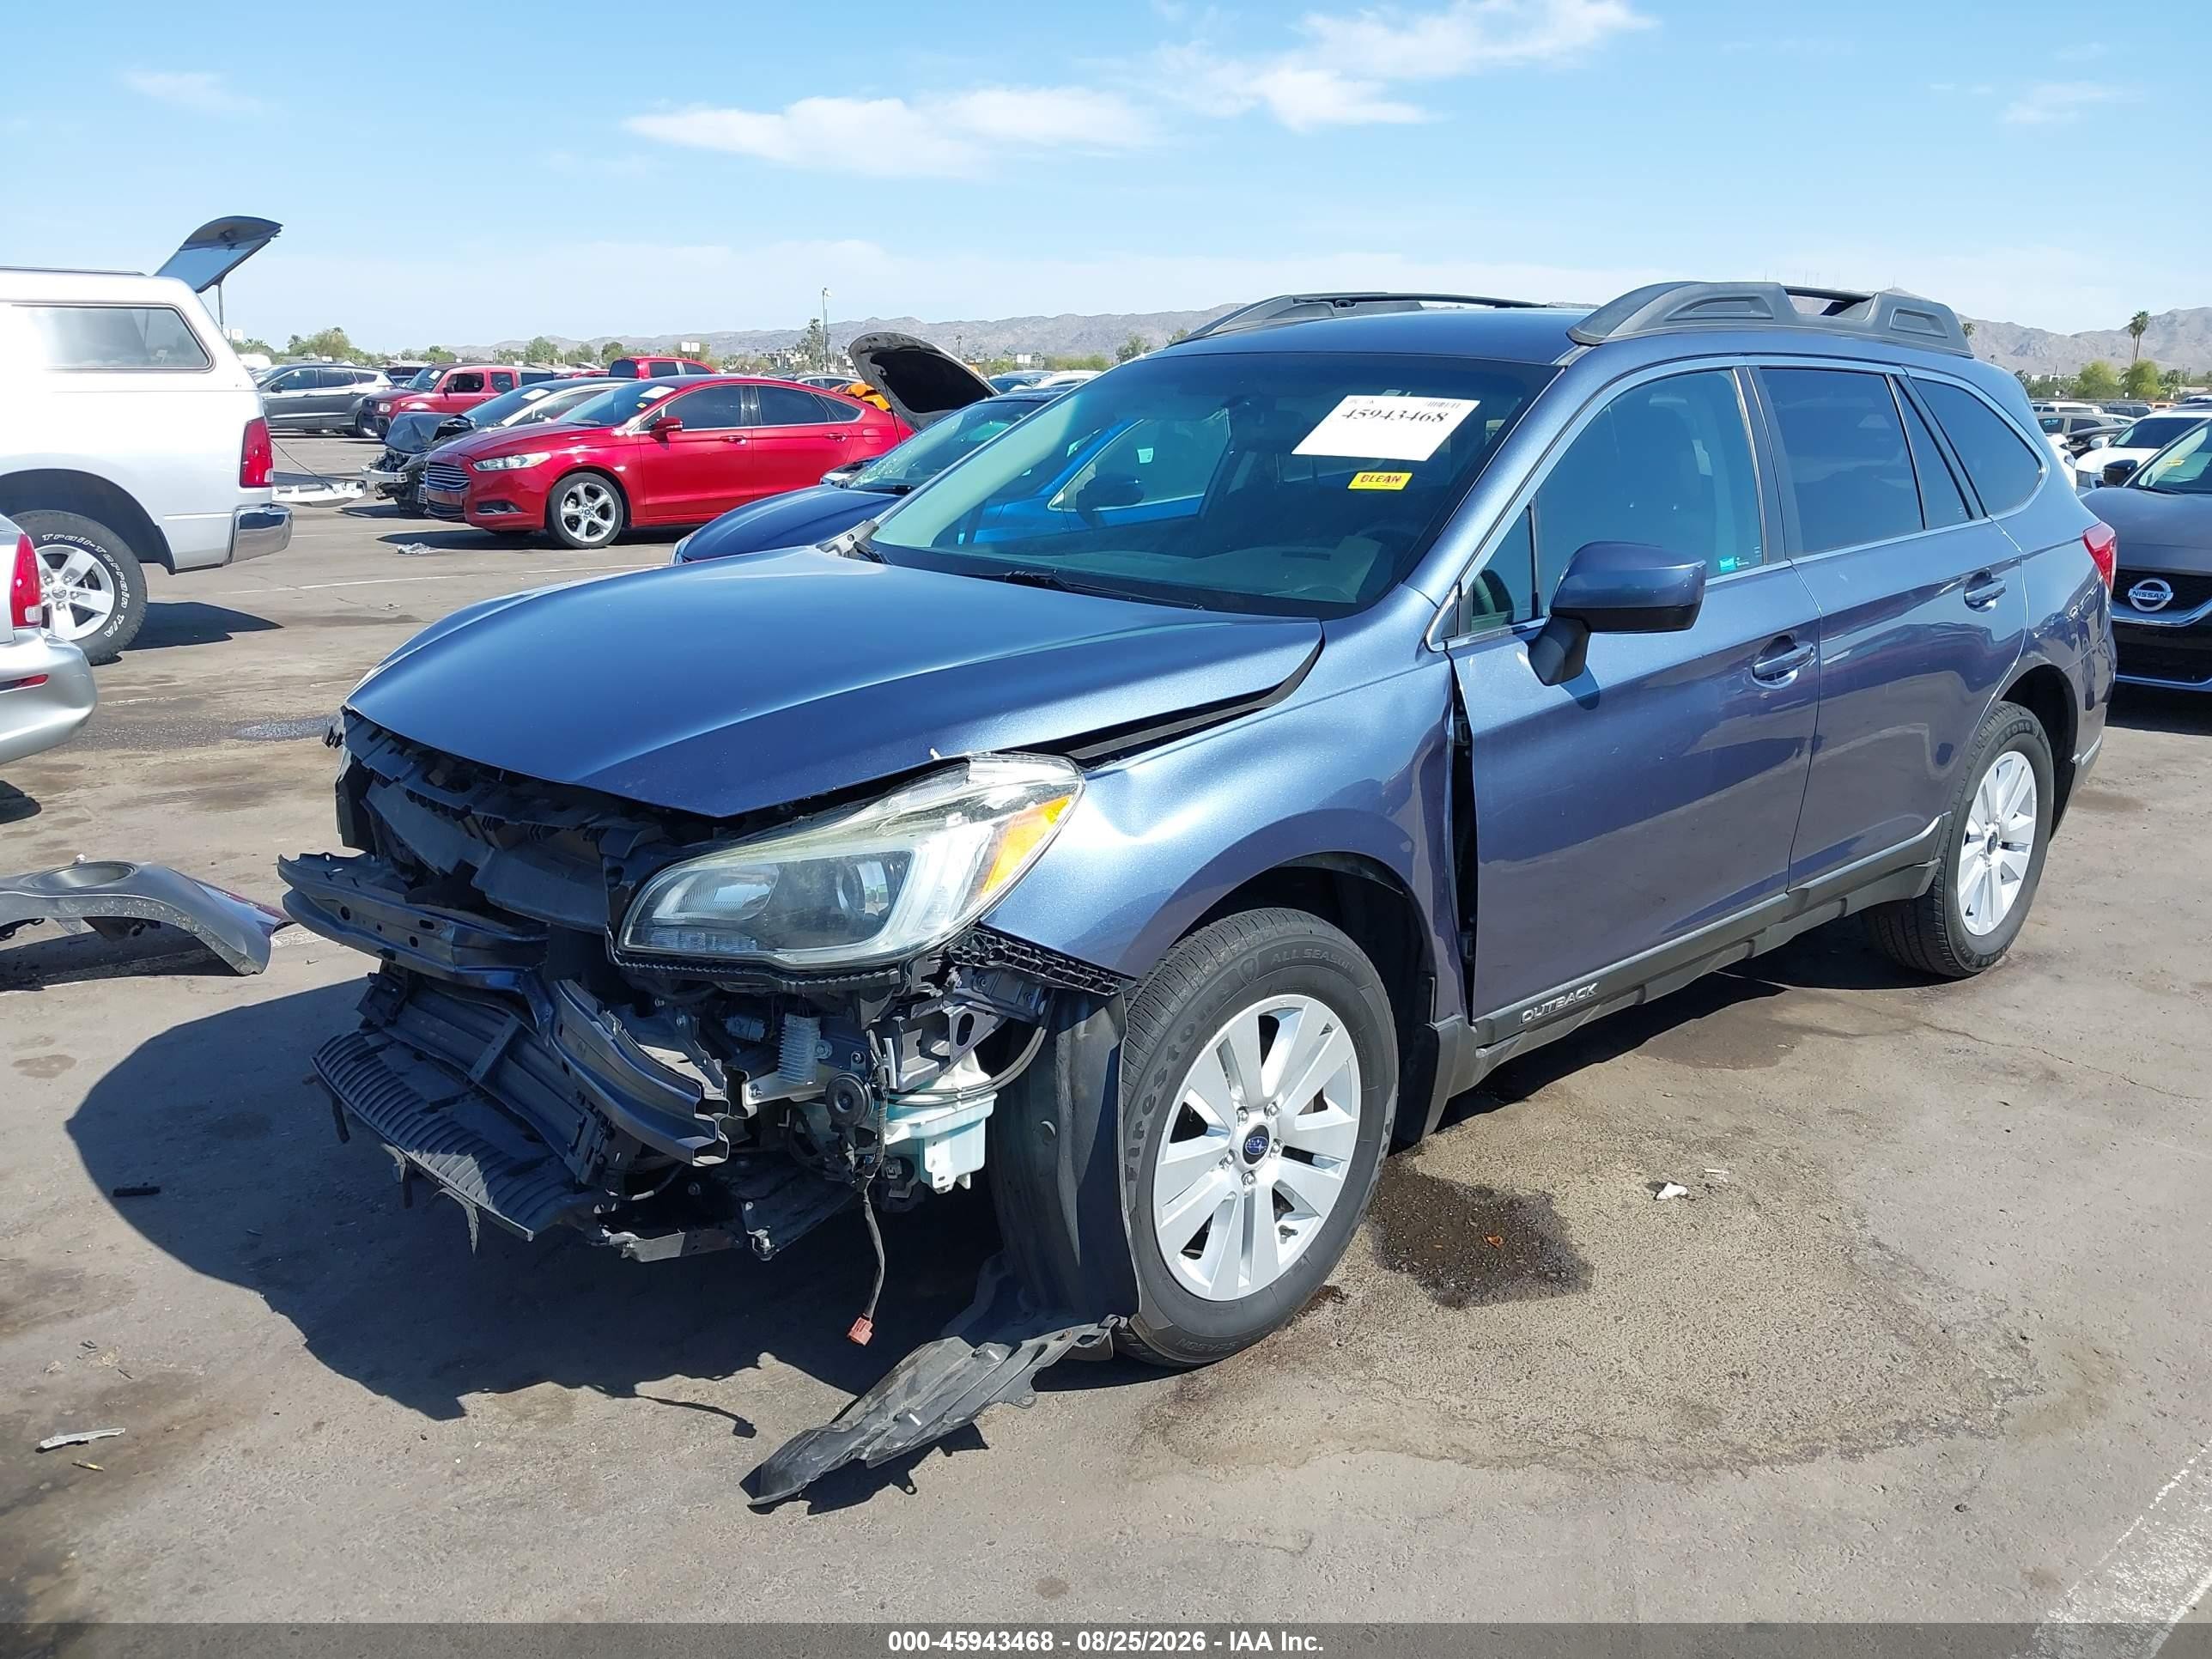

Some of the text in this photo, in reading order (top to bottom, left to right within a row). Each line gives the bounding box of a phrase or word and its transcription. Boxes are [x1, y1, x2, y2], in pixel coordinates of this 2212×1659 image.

[1341, 408, 1449, 422] 45943468
[41, 533, 130, 609] Trail-Terrain
[2132, 590, 2167, 599] NISSAN
[1271, 949, 1299, 966] ALL
[1522, 982, 1598, 1022] OUTBACK
